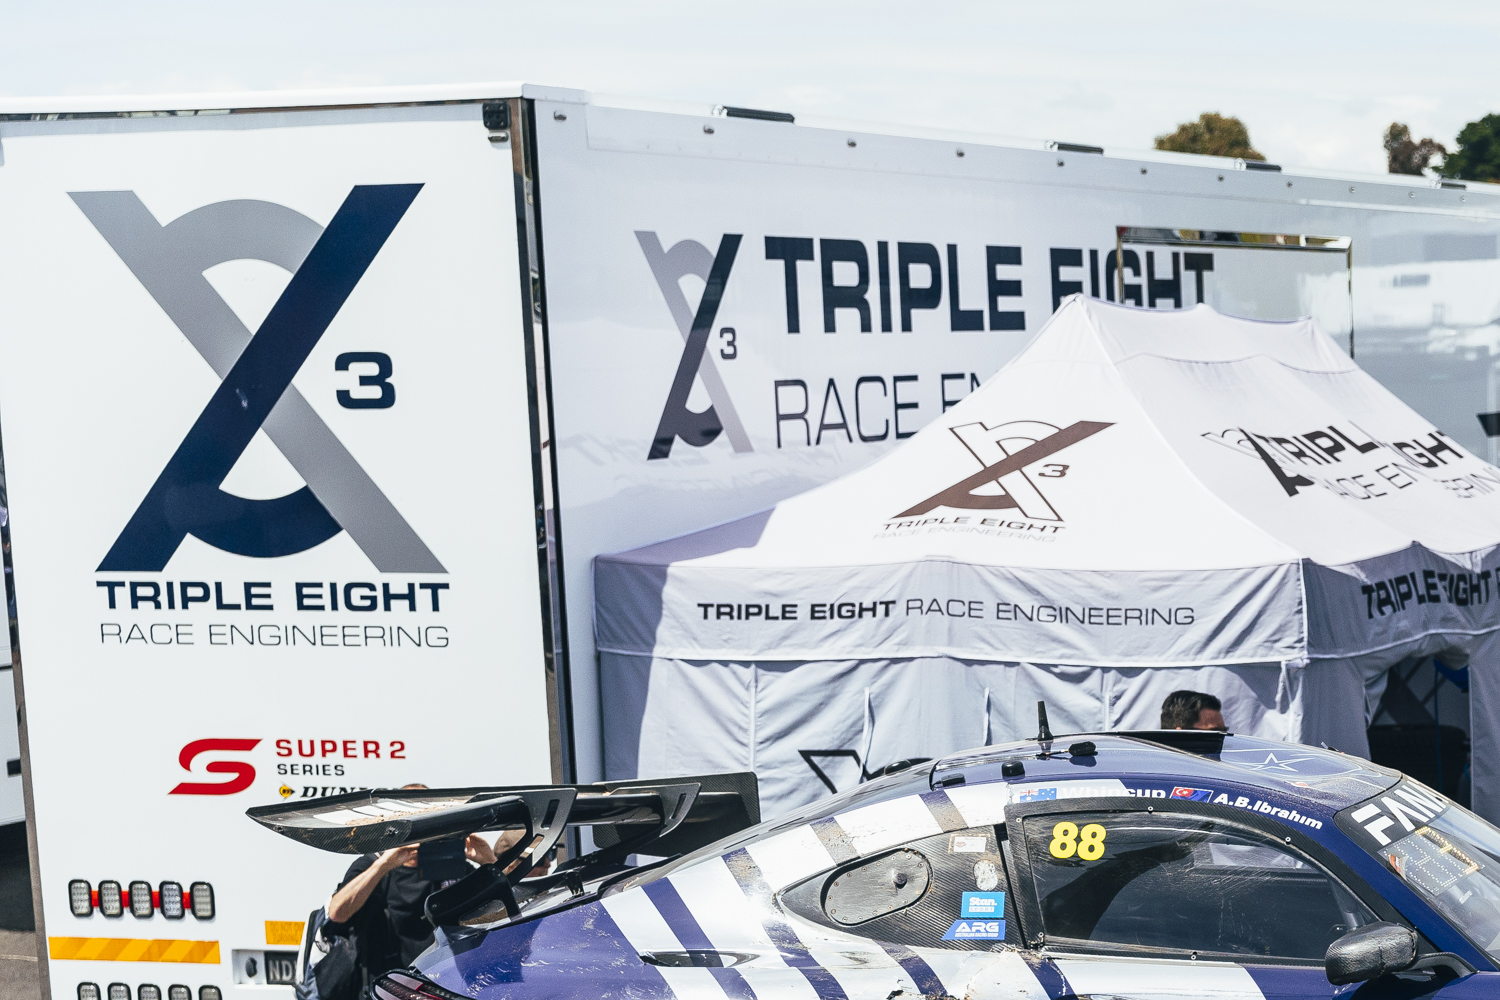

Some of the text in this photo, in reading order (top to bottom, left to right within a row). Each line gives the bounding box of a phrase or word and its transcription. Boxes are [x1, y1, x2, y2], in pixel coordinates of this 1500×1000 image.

[764, 235, 1026, 333] TRIPLE
[334, 351, 397, 409] 3
[774, 375, 918, 449] RACE
[883, 515, 1066, 534] TRIPLE EIGHT
[96, 580, 450, 613] TRIPLE EIGHT
[1361, 569, 1441, 619] TRIPLE
[697, 598, 1196, 626] TRIPLE EIGHT RACE ENGINEERING
[100, 622, 450, 649] RACE ENGINEERING
[276, 739, 406, 759] SUPER 2
[277, 763, 345, 776] SERIES
[1049, 821, 1107, 860] 88
[955, 922, 1000, 932] ARG
[269, 960, 298, 981] ND
